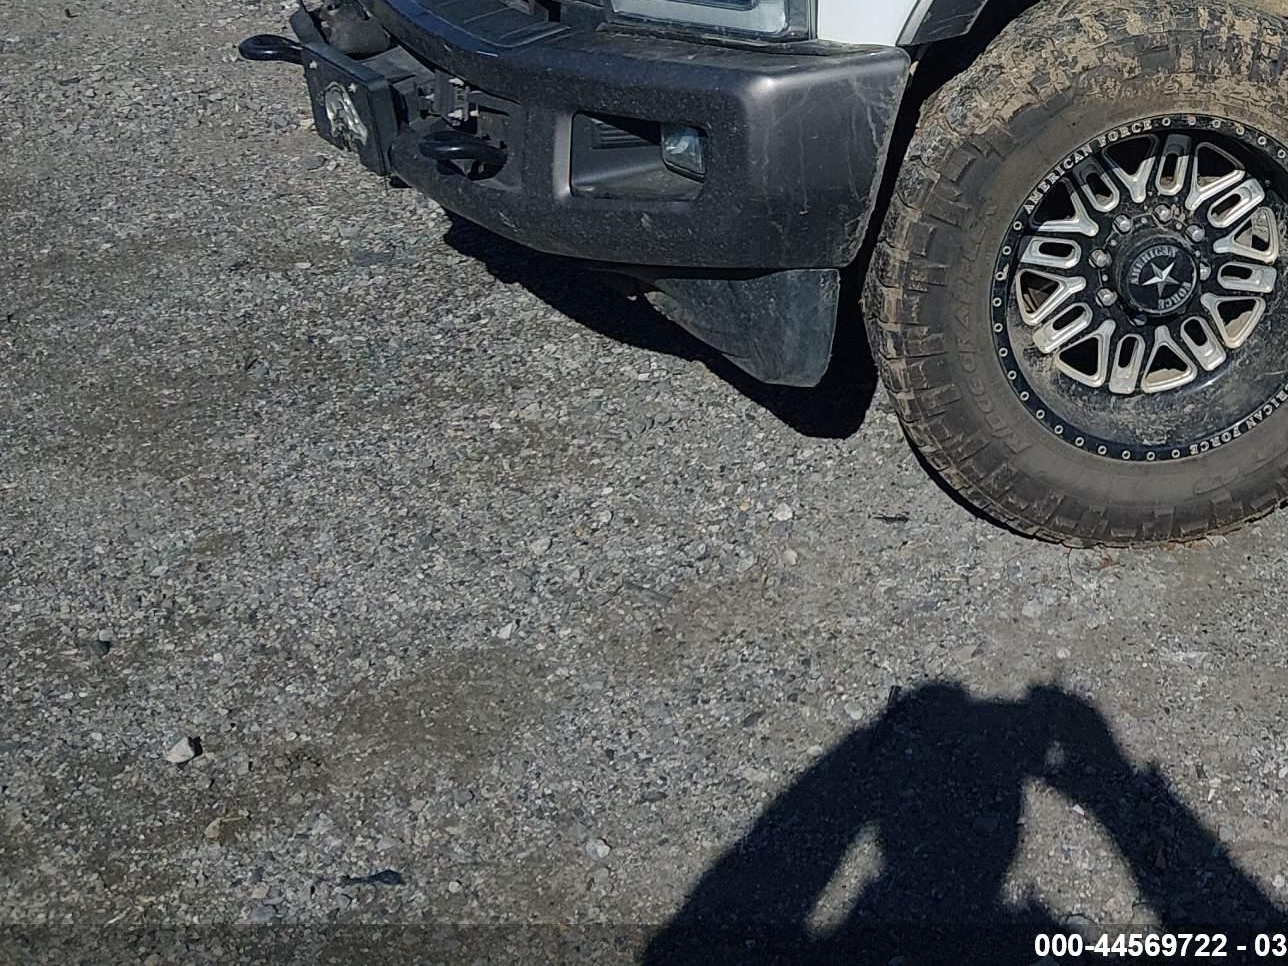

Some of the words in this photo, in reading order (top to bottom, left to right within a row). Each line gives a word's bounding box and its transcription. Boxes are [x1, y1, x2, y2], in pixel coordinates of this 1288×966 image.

[1023, 144, 1093, 215] AMERICAN
[1098, 120, 1152, 148] FORCE
[1130, 245, 1178, 285] AMERICAN
[1158, 281, 1192, 309] FORCE
[1189, 426, 1241, 455] FORCE
